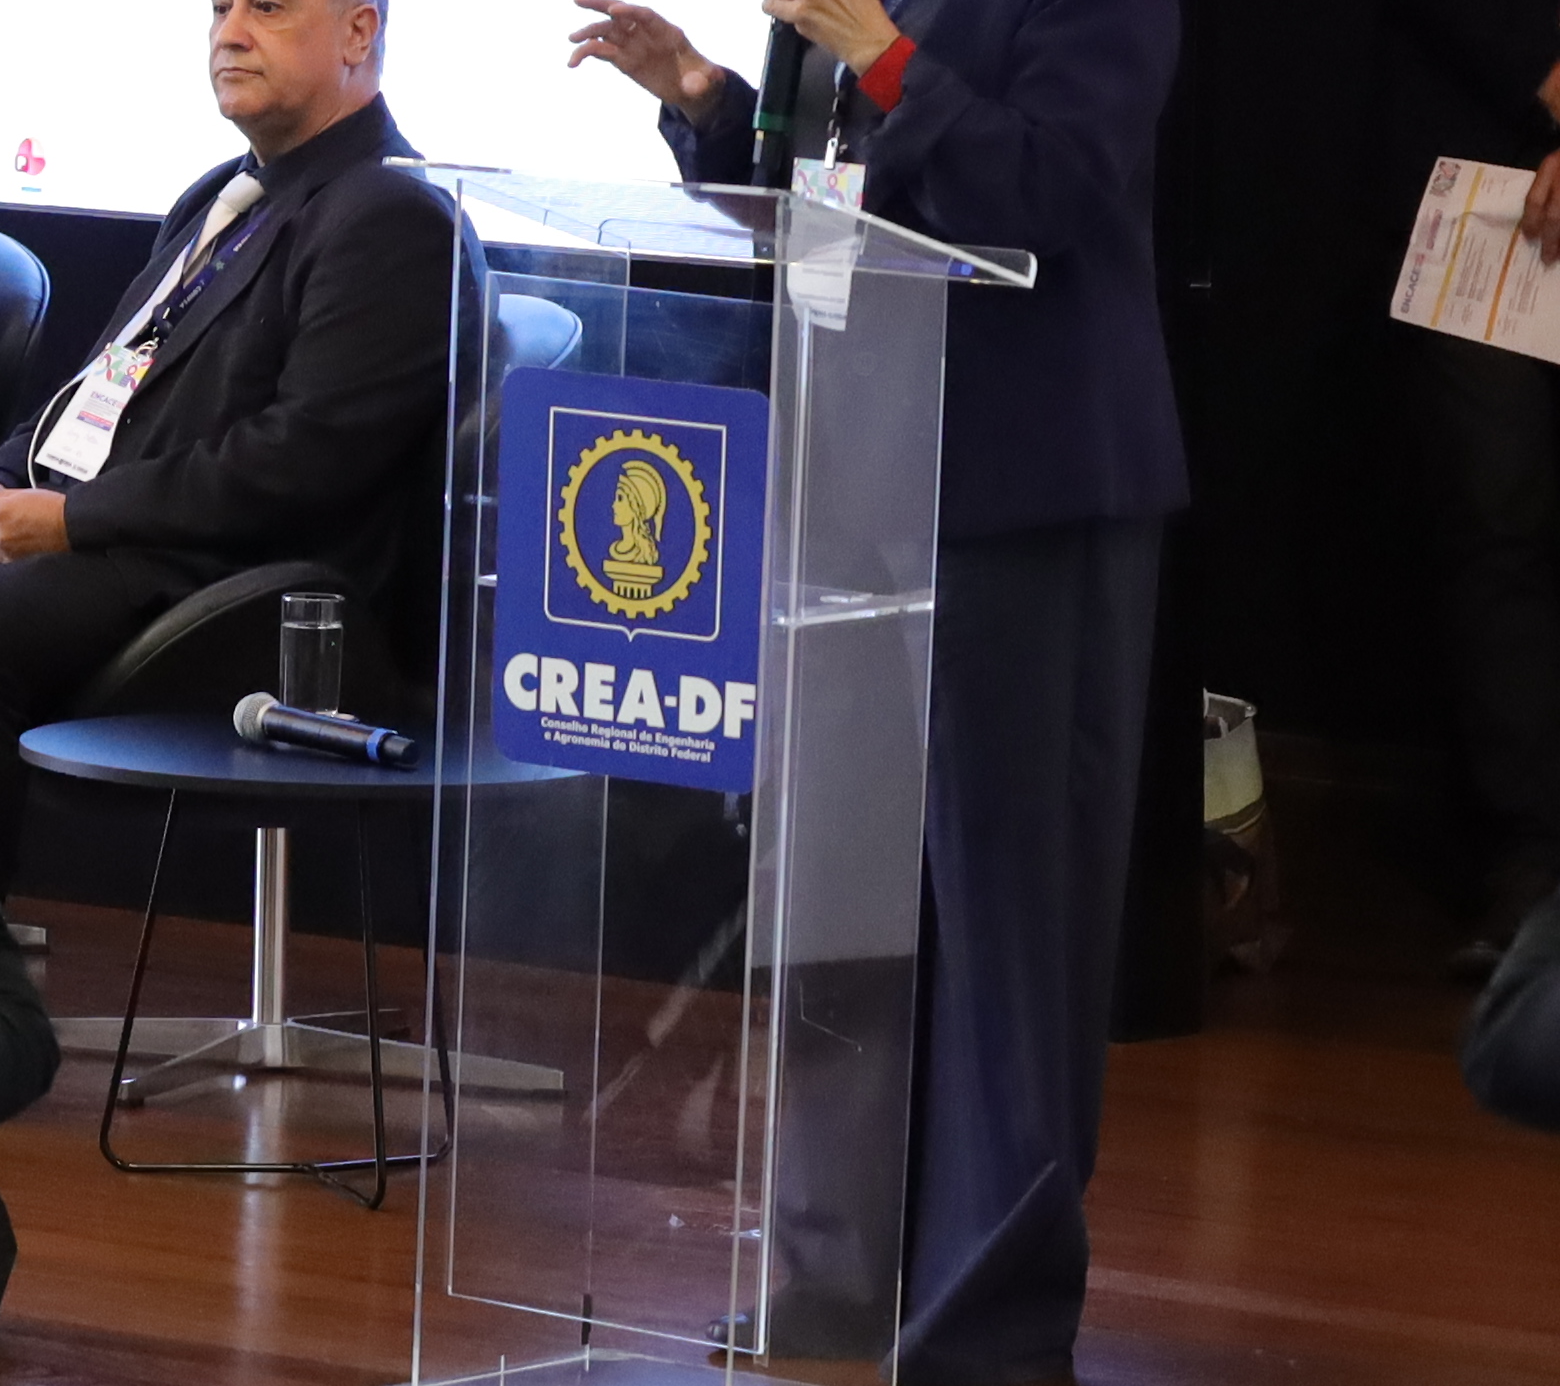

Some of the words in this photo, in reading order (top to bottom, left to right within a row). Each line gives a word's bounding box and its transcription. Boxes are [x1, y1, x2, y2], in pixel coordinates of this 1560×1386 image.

[503, 653, 756, 739] CREA-DF
[540, 717, 589, 734] Conselho
[590, 723, 637, 740] Regional
[639, 730, 653, 742] de
[654, 732, 716, 751] Engenharia
[544, 731, 552, 741] e
[553, 731, 611, 749] Agronomia
[612, 739, 626, 752] do
[629, 741, 669, 757] Distrito
[670, 749, 711, 763] Federal
